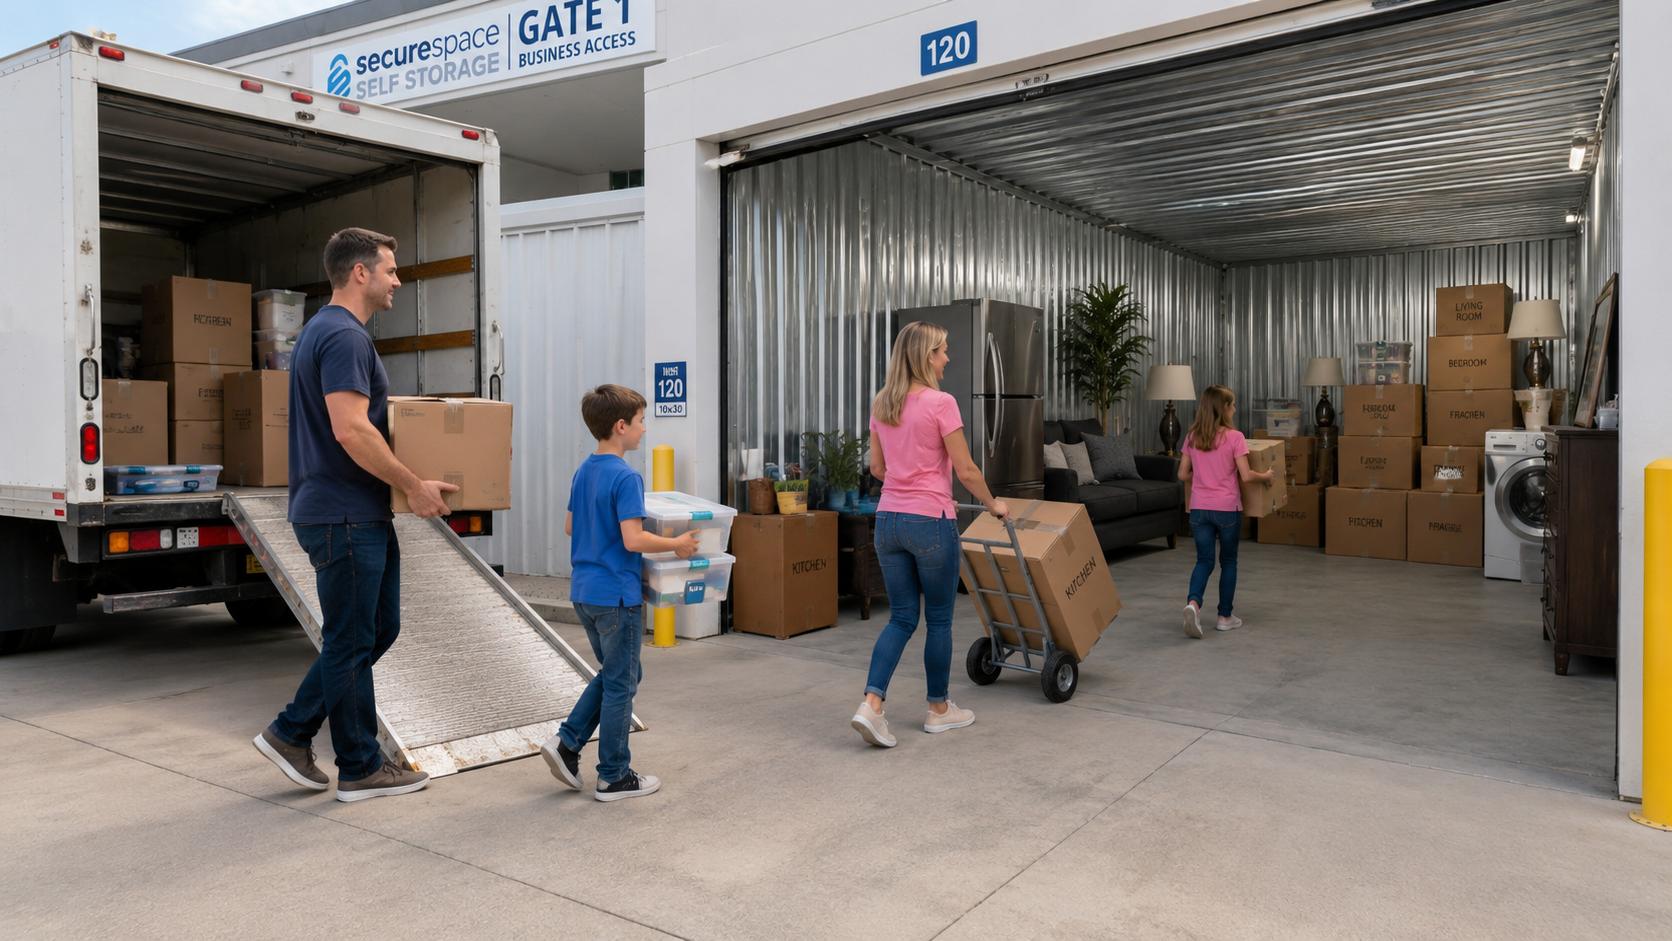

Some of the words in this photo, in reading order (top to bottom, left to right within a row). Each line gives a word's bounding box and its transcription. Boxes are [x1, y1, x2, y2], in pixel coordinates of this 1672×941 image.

[518, 0, 602, 45] GATE
[615, 0, 629, 24] 1
[356, 24, 500, 75] securespace
[519, 42, 580, 68] BUSINESS
[584, 31, 636, 54] ACCESS
[927, 31, 971, 66] 120
[356, 74, 399, 99] SELF
[405, 52, 500, 90] STORAGE
[1456, 311, 1482, 321] ROOM
[658, 378, 683, 398] 120
[659, 404, 683, 414] 10x30
[791, 558, 827, 576] KITCHEN
[1065, 556, 1097, 601] KITCHEN
